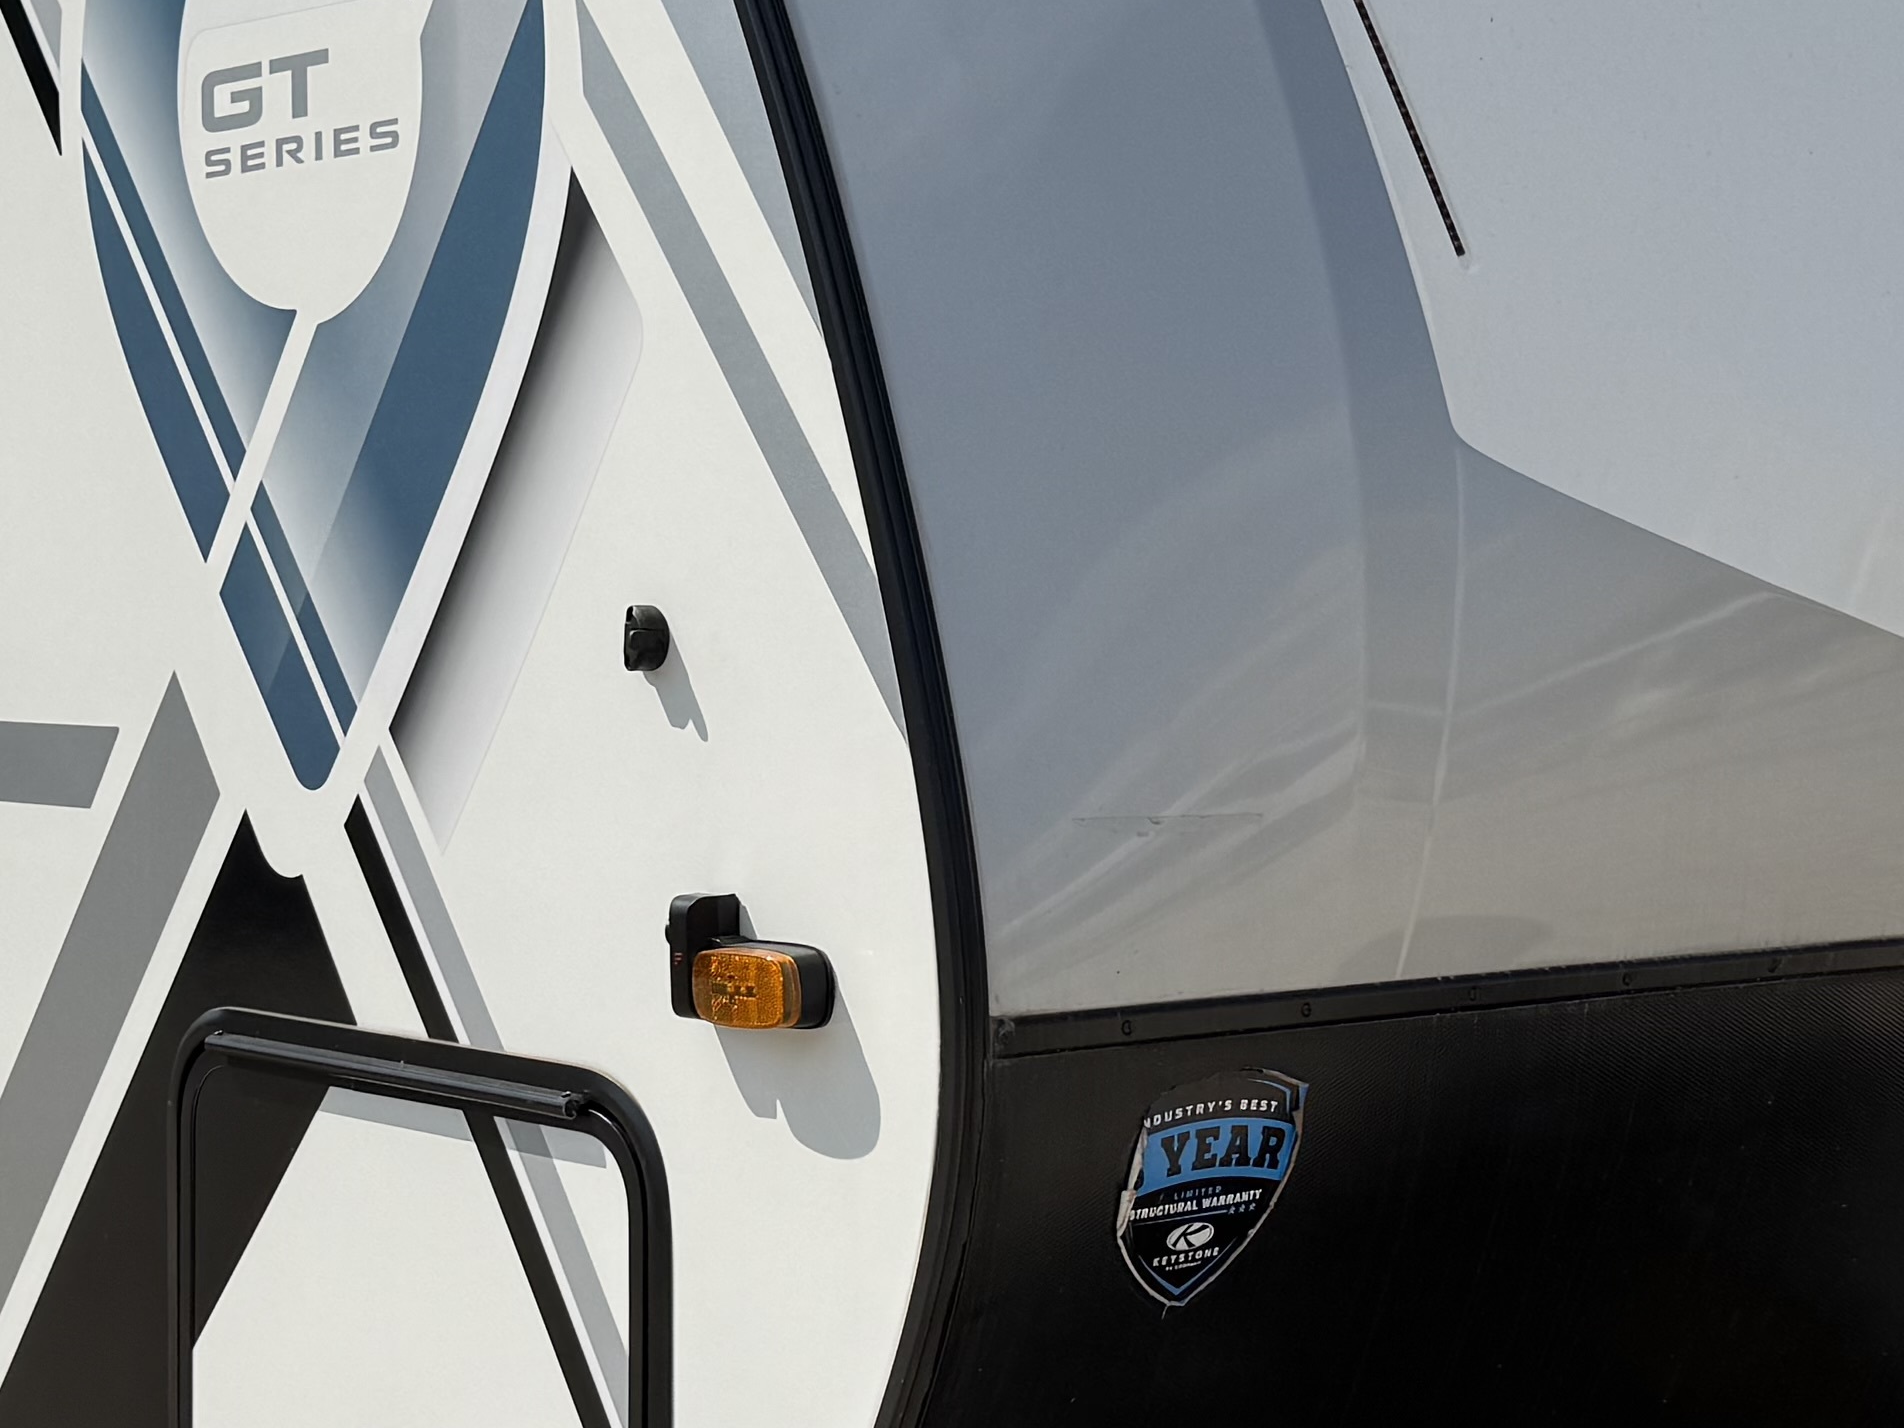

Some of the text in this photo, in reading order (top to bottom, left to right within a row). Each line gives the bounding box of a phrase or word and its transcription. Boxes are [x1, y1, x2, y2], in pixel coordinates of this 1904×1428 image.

[201, 48, 329, 133] GT
[204, 117, 400, 179] SERIES
[1143, 1098, 1279, 1129] NDUSTRY'S BEST
[1161, 1125, 1287, 1177] YEAR
[1174, 1185, 1222, 1201] LIMITED
[1202, 1188, 1263, 1209] WARRANTY
[1152, 1246, 1220, 1267] KEYSTONE
